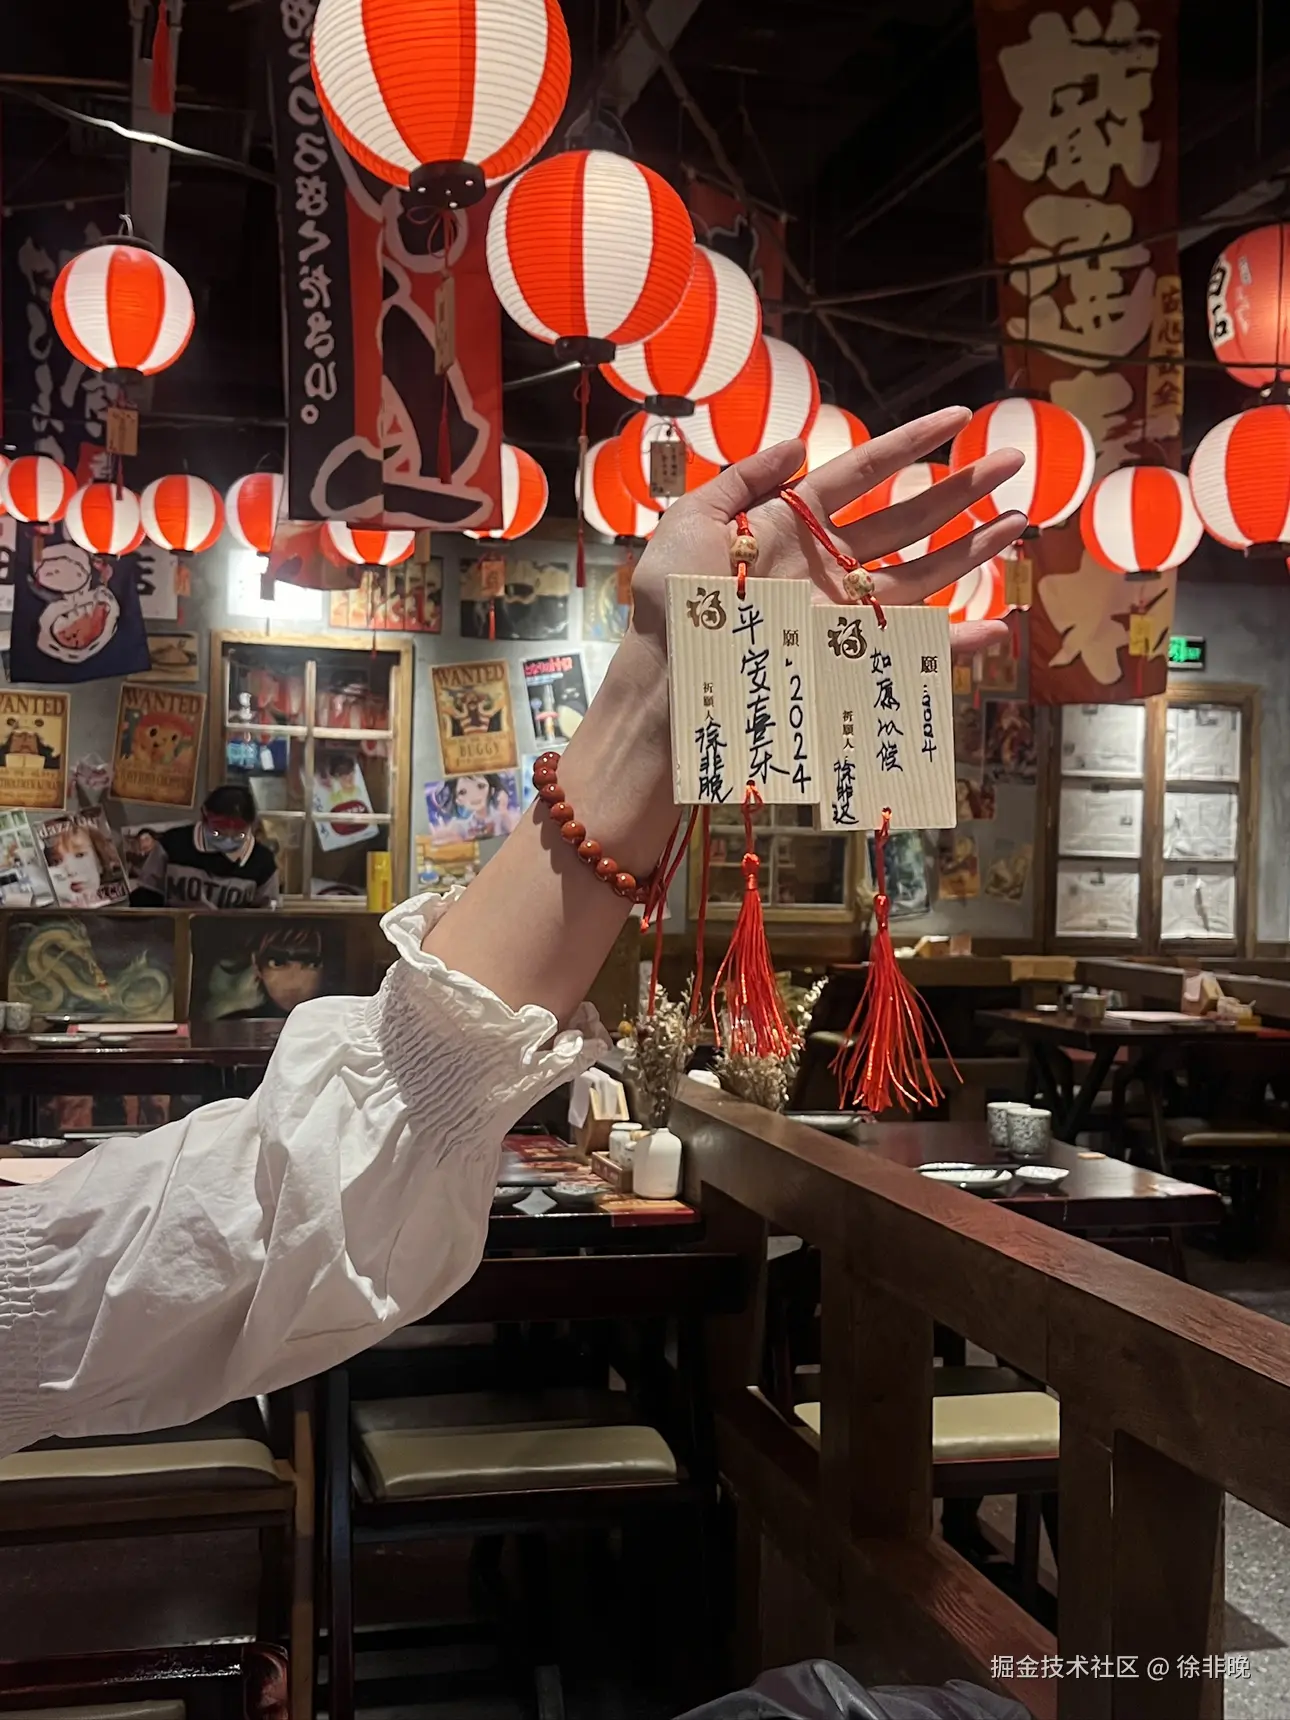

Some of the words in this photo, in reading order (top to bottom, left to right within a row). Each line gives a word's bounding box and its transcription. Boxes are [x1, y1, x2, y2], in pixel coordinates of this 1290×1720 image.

[434, 663, 506, 687] WANTED
[0, 693, 66, 716] ANTED
[122, 690, 201, 716] WANTED
